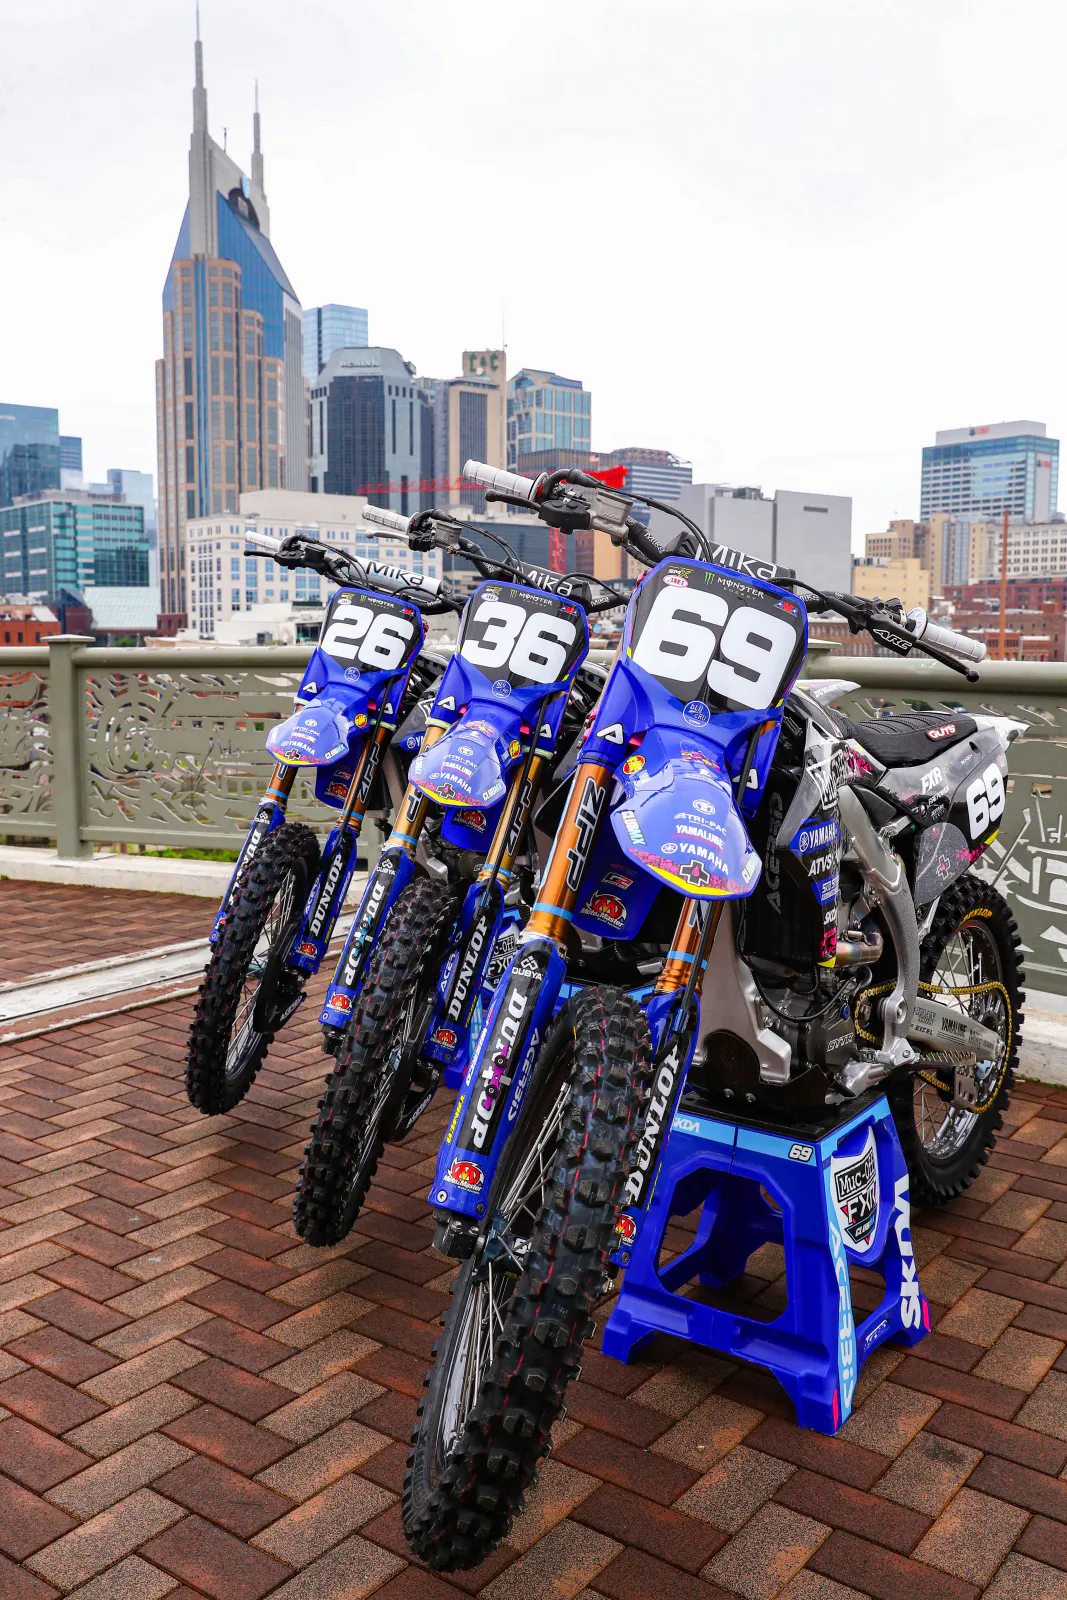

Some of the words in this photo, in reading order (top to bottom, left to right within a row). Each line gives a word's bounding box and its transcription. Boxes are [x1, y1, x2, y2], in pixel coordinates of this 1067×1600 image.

[717, 577, 764, 599] MONSTER
[320, 604, 415, 670] 26
[460, 600, 577, 684] 36
[632, 586, 797, 710] 69
[288, 740, 316, 756] YAMAHA
[928, 724, 957, 739] GUTS
[440, 772, 472, 794] YAMAHA
[920, 766, 943, 796] FXR
[966, 763, 1006, 840] 69
[676, 825, 726, 850] YAMALUBE
[679, 843, 729, 876] YAMAHA
[310, 854, 344, 937] DUNLOP
[448, 916, 487, 1021] DUNLOP
[511, 966, 543, 981] DUBYA
[625, 1043, 679, 1202] DUNLOP
[789, 1144, 813, 1161] 69
[894, 1173, 922, 1329] SKDA
[829, 1220, 855, 1409] ACERBIS
